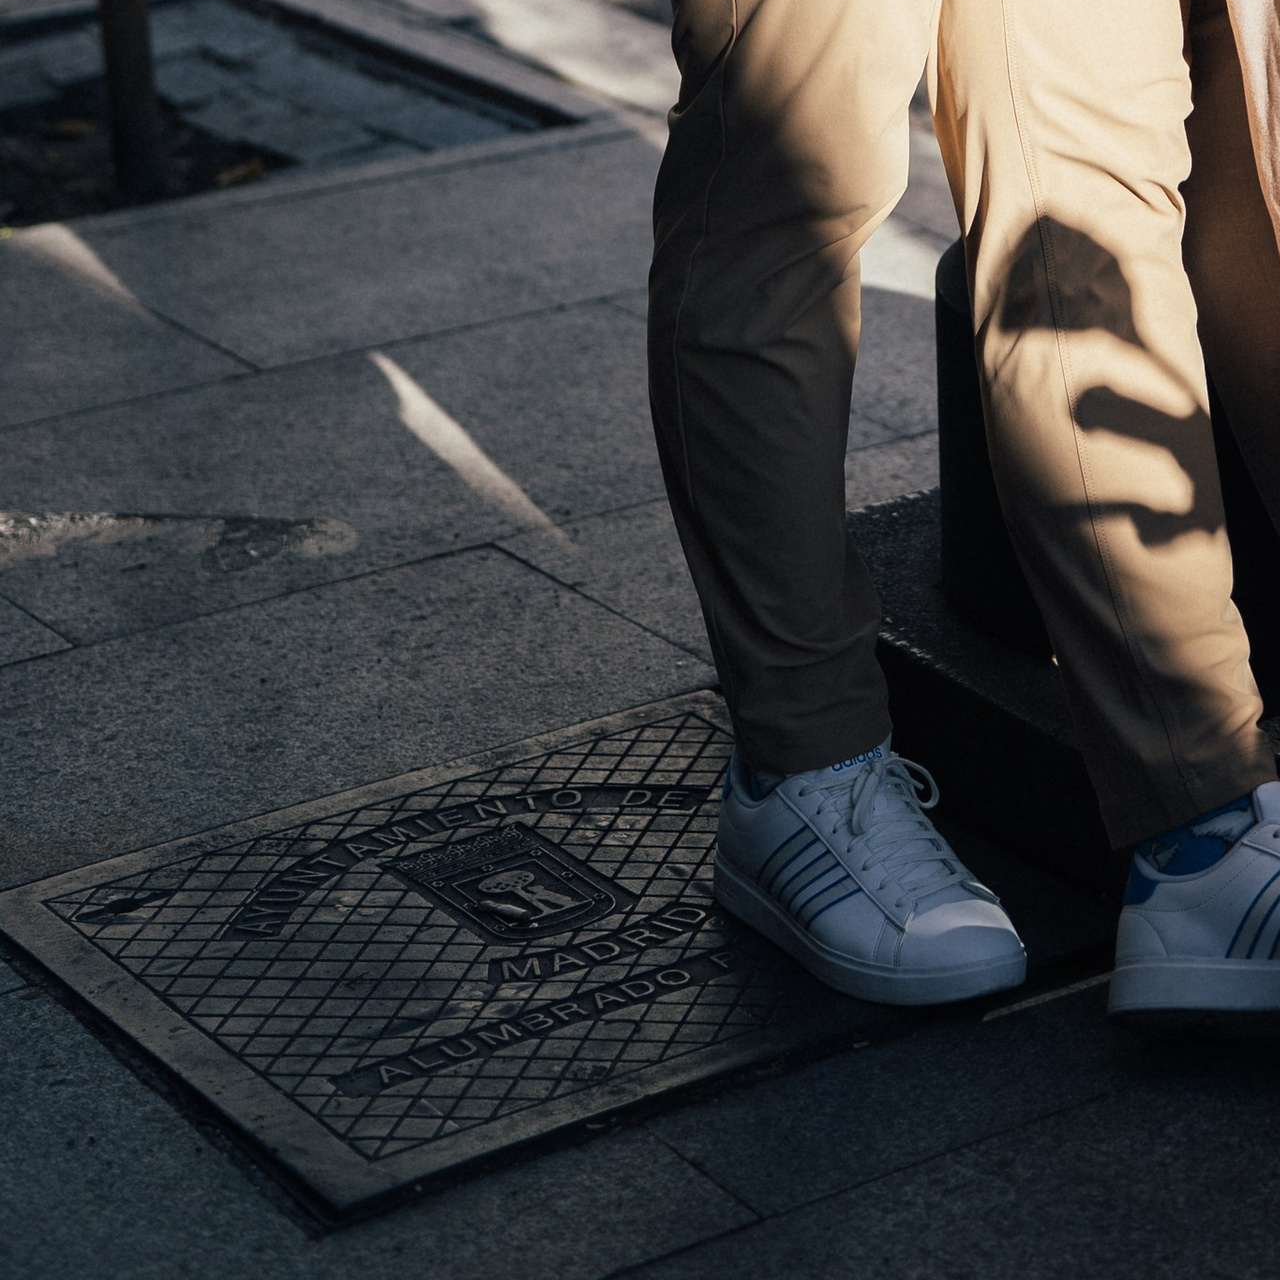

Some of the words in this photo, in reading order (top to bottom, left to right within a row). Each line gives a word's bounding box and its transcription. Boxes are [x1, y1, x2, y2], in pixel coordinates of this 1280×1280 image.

[235, 788, 584, 936] AYUNTAMIENTO
[620, 788, 690, 808] DE
[501, 906, 705, 981] MADRID
[378, 968, 695, 1085] ALUMBRADO
